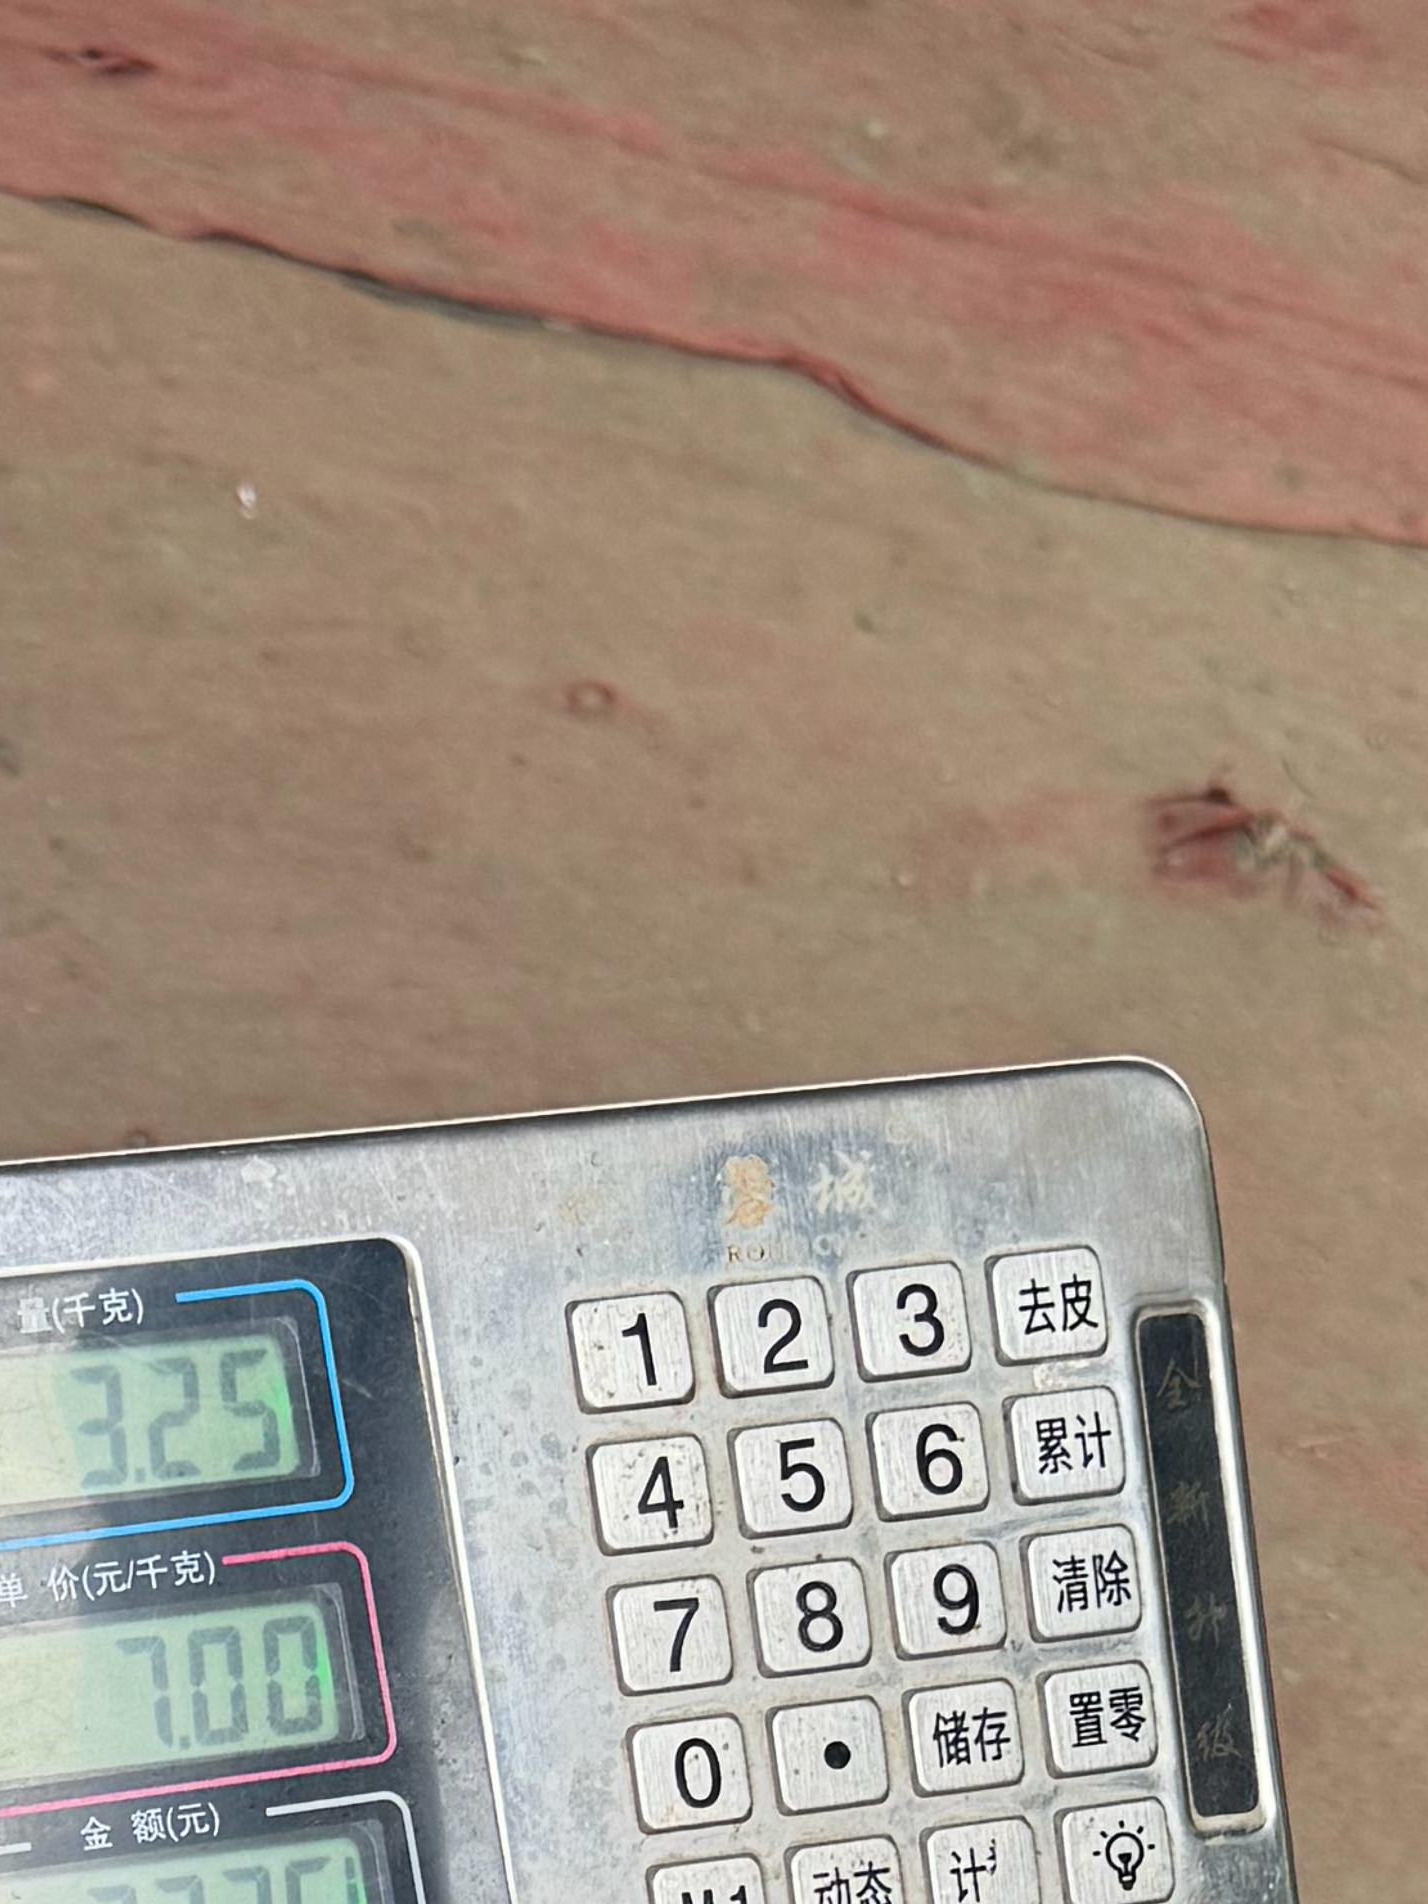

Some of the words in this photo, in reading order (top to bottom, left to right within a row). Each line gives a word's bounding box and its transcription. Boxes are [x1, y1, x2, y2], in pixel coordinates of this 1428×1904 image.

[757, 1298, 809, 1375] 2
[895, 1282, 945, 1357] 3
[1018, 1272, 1100, 1337] 去皮
[621, 1312, 658, 1387] 1
[72, 1347, 281, 1489] 3.25
[1034, 1410, 1112, 1476] 累计
[637, 1455, 685, 1529] 4
[778, 1437, 826, 1513] 5
[915, 1422, 964, 1495] 6
[795, 1580, 843, 1652] 8
[932, 1563, 981, 1636] 9
[1051, 1548, 1133, 1613] 清除
[652, 1597, 700, 1673] 7
[114, 1614, 324, 1751] 7.00
[1068, 1685, 1147, 1749] 置零
[673, 1736, 722, 1809] 0
[932, 1706, 1012, 1769] 储存
